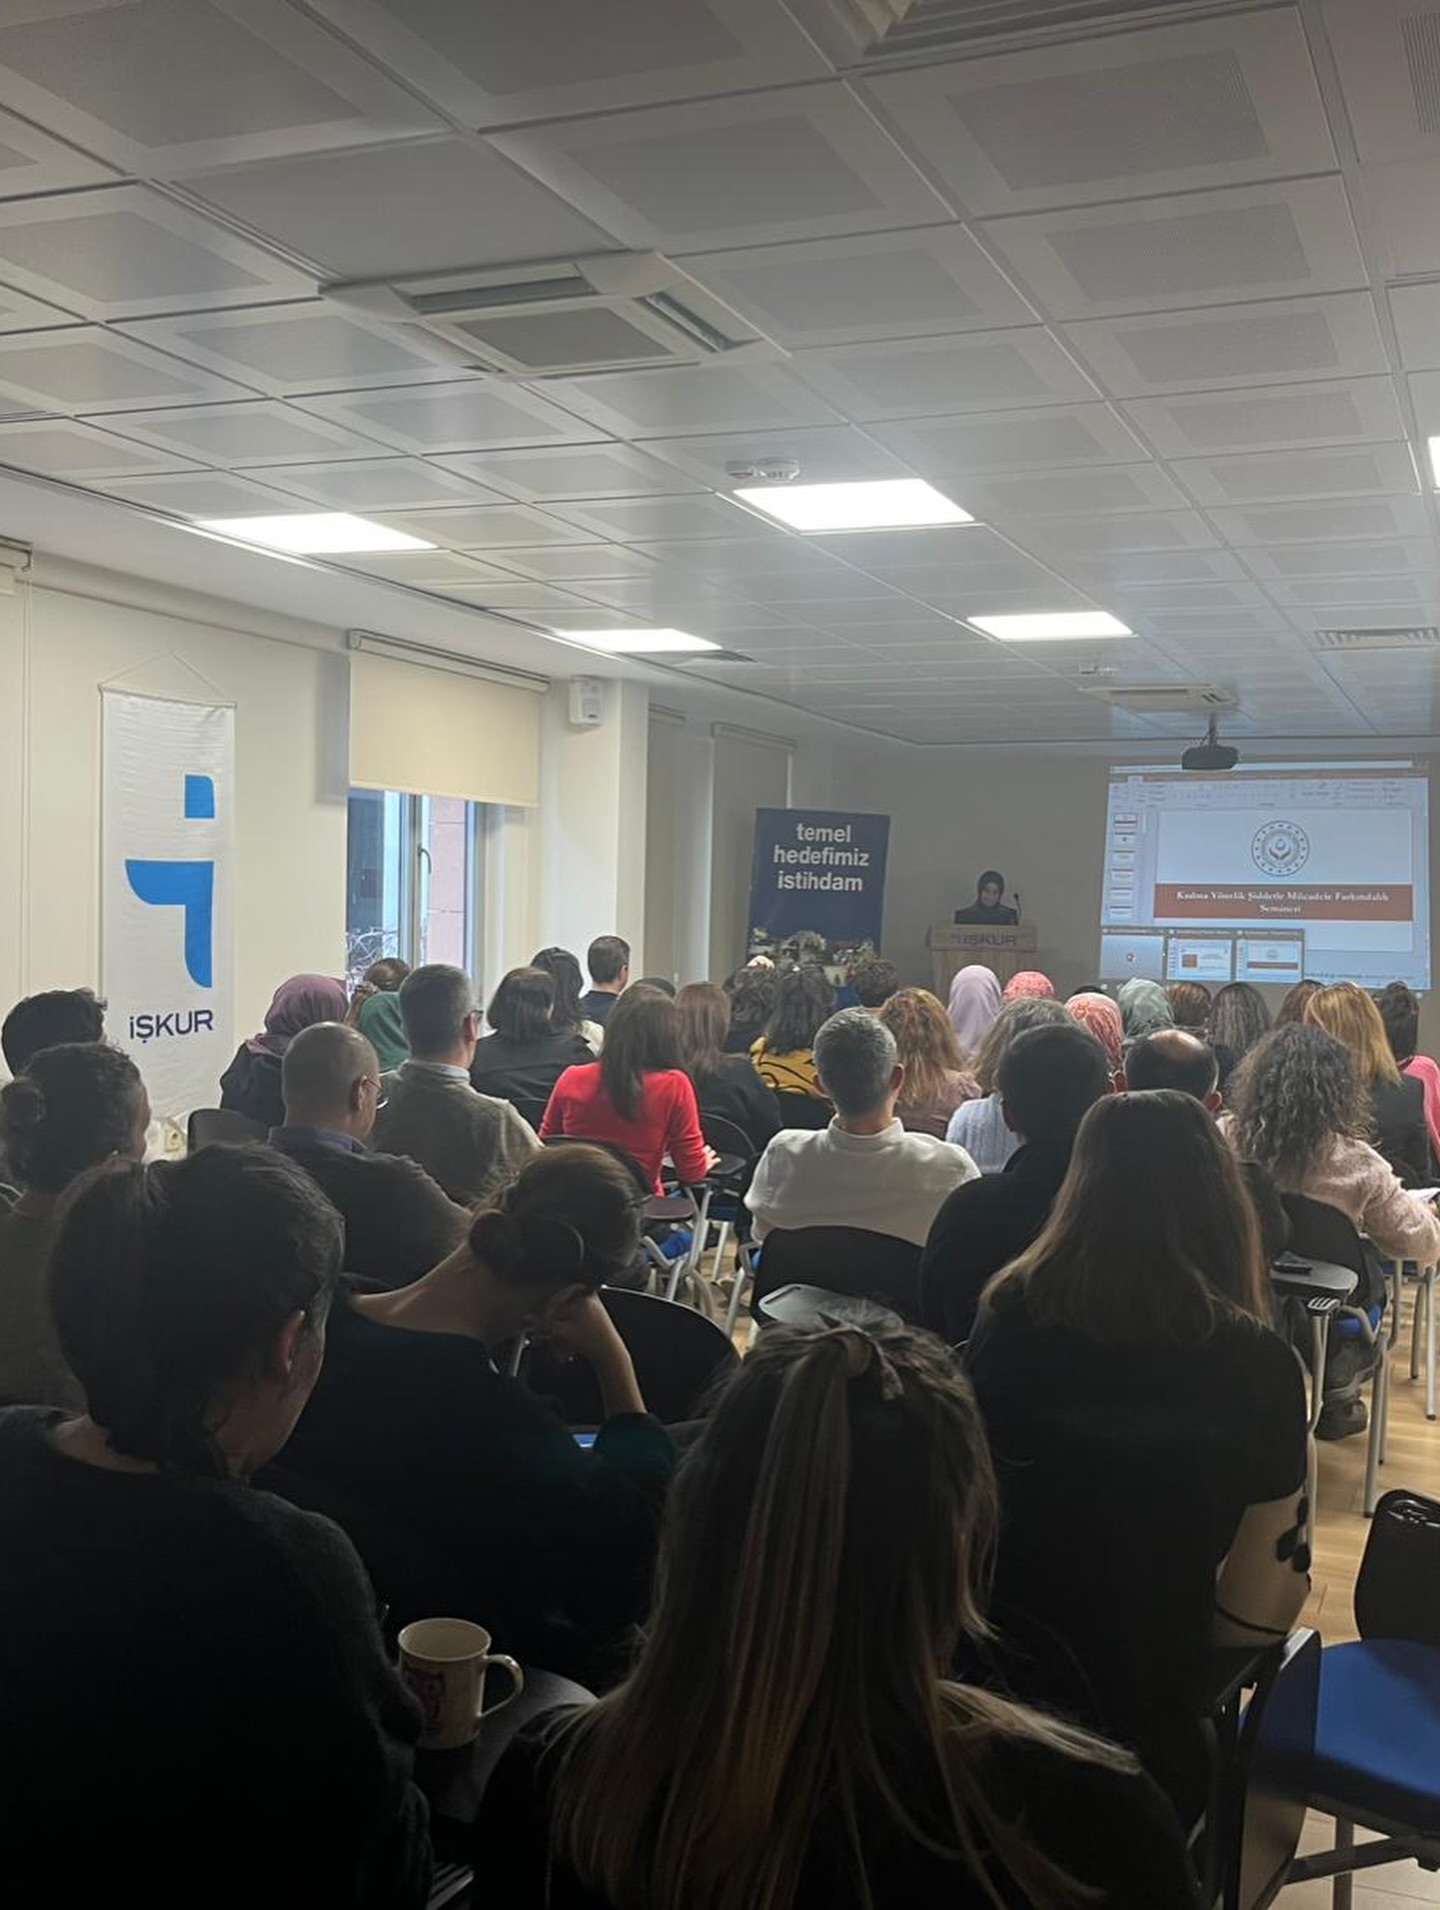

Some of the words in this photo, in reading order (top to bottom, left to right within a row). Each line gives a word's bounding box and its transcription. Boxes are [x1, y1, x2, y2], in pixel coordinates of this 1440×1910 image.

[797, 823, 851, 842] temel
[773, 845, 869, 866] hedefimiz
[778, 870, 862, 891] istihdam
